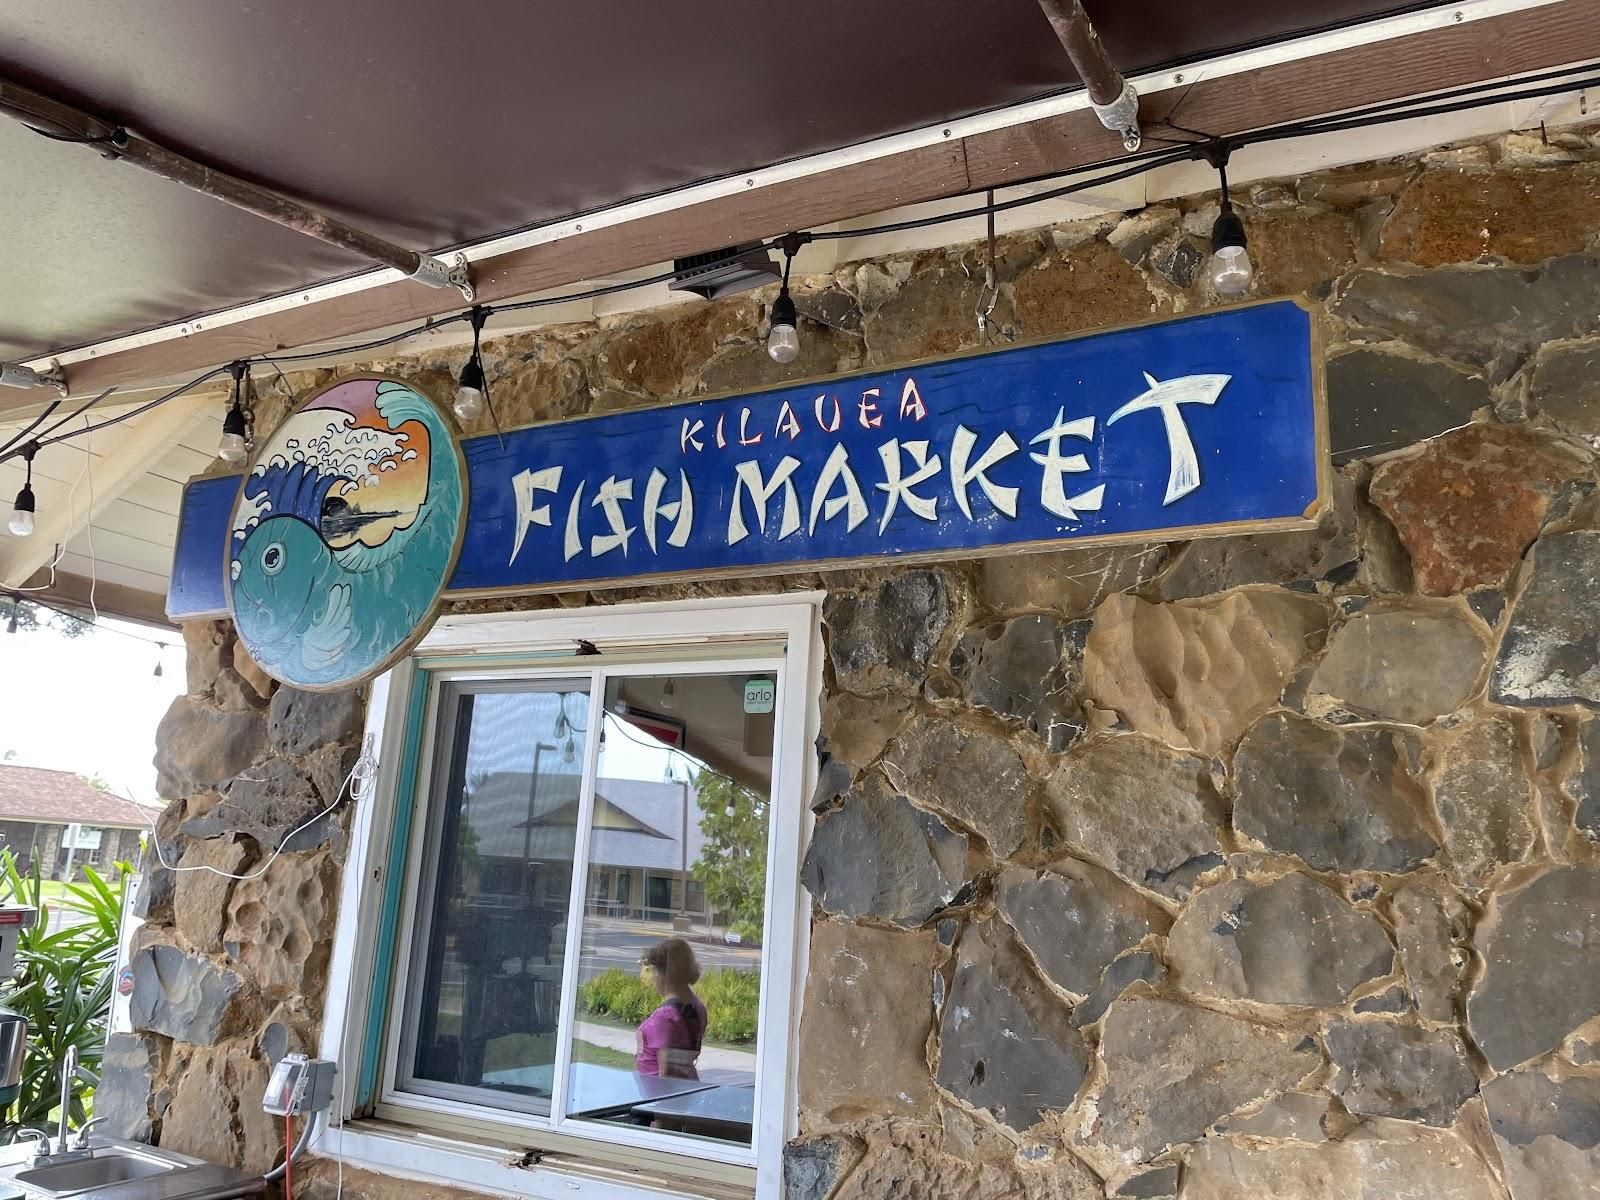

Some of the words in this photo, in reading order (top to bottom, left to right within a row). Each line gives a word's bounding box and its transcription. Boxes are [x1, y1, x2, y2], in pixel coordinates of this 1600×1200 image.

[680, 377, 927, 454] KILAUEA
[509, 466, 693, 567] FISH
[728, 371, 1232, 546] MARKET
[747, 688, 771, 701] arlo
